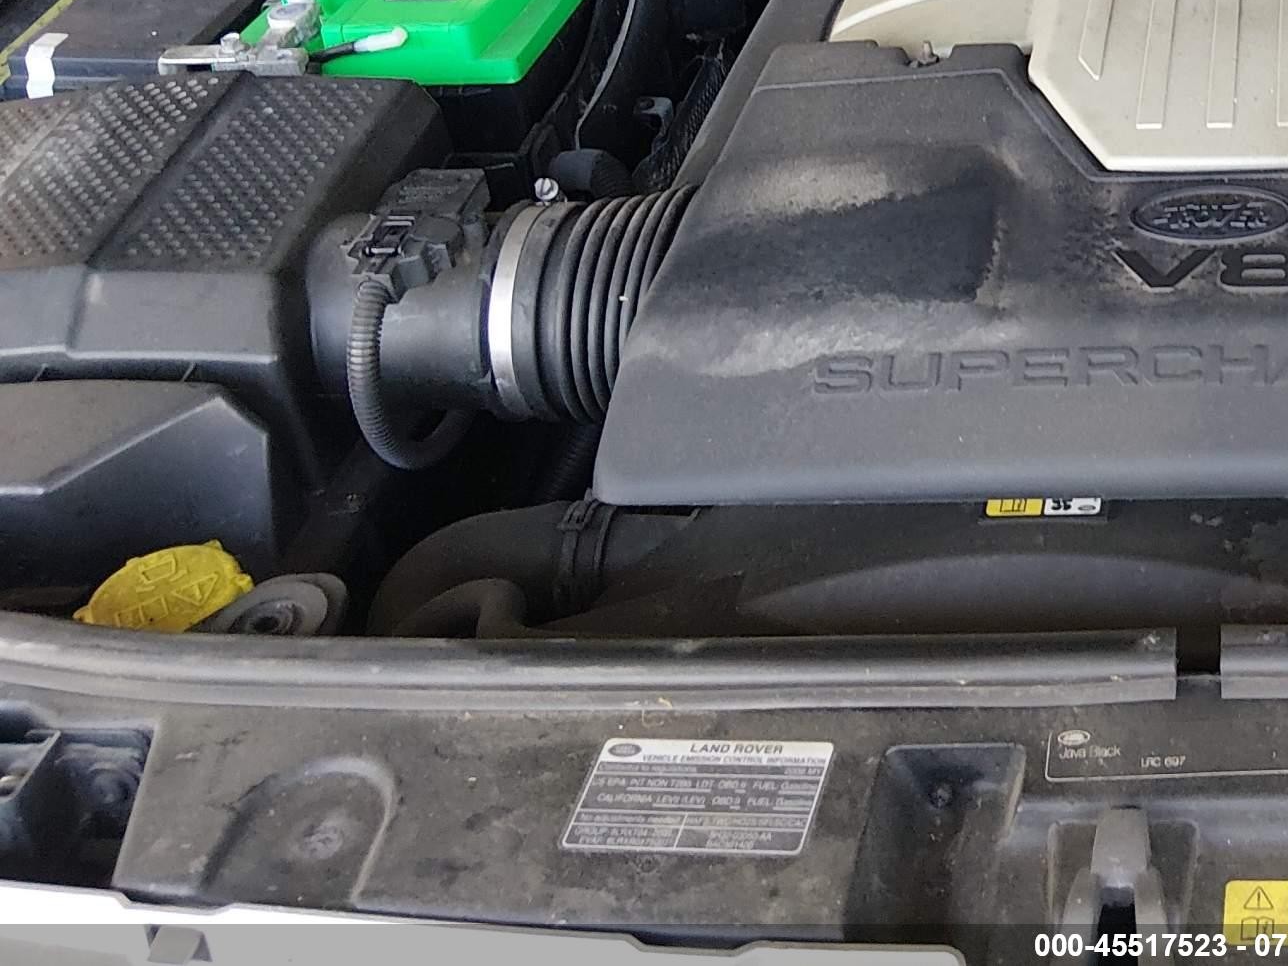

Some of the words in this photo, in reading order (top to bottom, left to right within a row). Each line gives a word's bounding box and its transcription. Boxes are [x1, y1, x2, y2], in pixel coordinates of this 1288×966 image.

[690, 743, 730, 753] LAND
[734, 744, 783, 754] ROVER
[1059, 746, 1087, 760] Java
